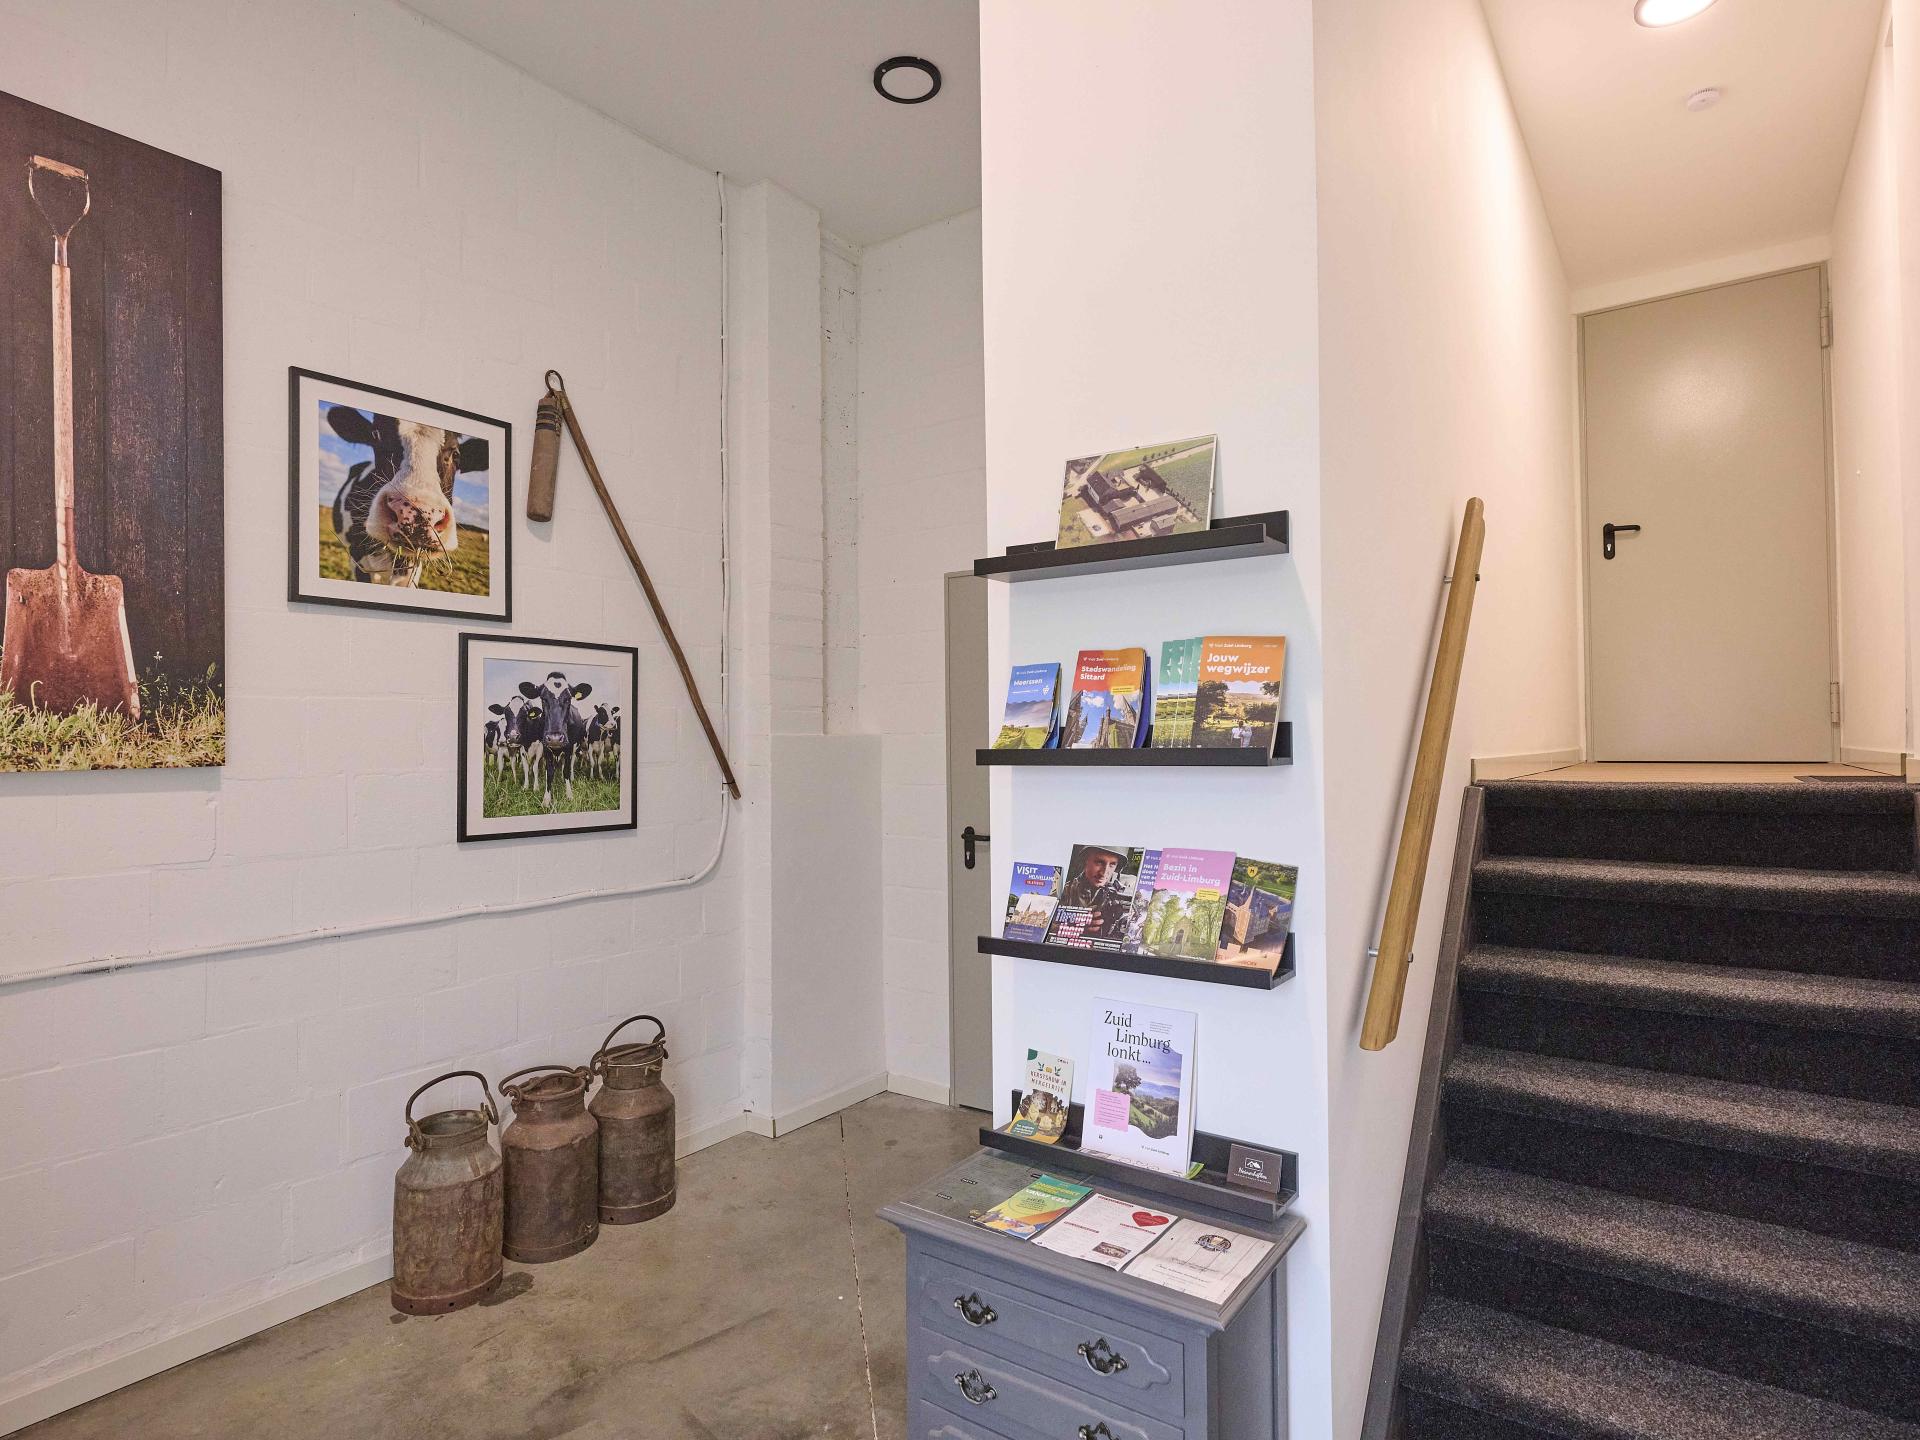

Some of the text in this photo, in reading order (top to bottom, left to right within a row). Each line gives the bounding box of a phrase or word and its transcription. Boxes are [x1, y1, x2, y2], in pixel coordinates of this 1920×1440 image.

[1206, 652, 1240, 663] Jouw
[1206, 662, 1271, 676] wegwijzer
[1079, 673, 1106, 681] Sittard
[1016, 865, 1039, 876] VISIT
[1163, 863, 1188, 872] Bezin
[1188, 864, 1198, 874] in
[1160, 873, 1221, 887] Zuid-Limburg
[1104, 1010, 1132, 1028] Zuid
[1116, 1028, 1171, 1055] Limburg
[1107, 1042, 1151, 1065] lonkt...
